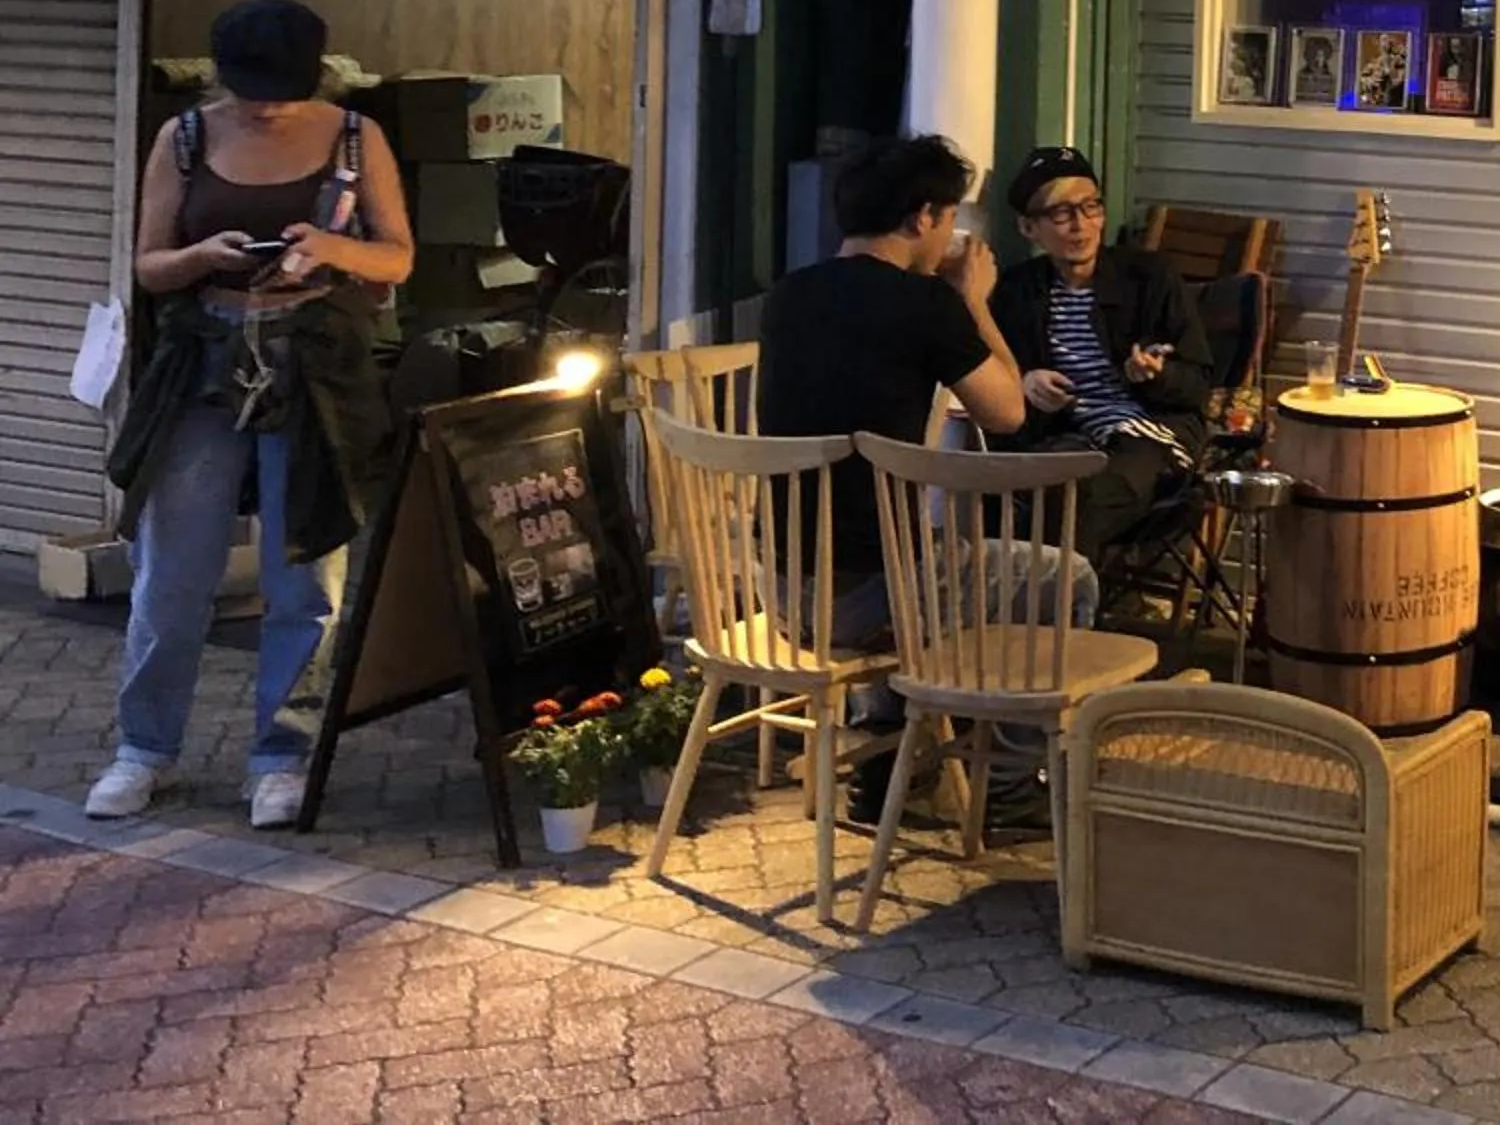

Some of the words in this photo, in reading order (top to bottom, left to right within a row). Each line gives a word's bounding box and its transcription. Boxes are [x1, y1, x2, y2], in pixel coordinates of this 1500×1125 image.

[489, 465, 586, 519] 泊まれる
[519, 509, 574, 547] BAR
[1397, 564, 1469, 598] COFFEE
